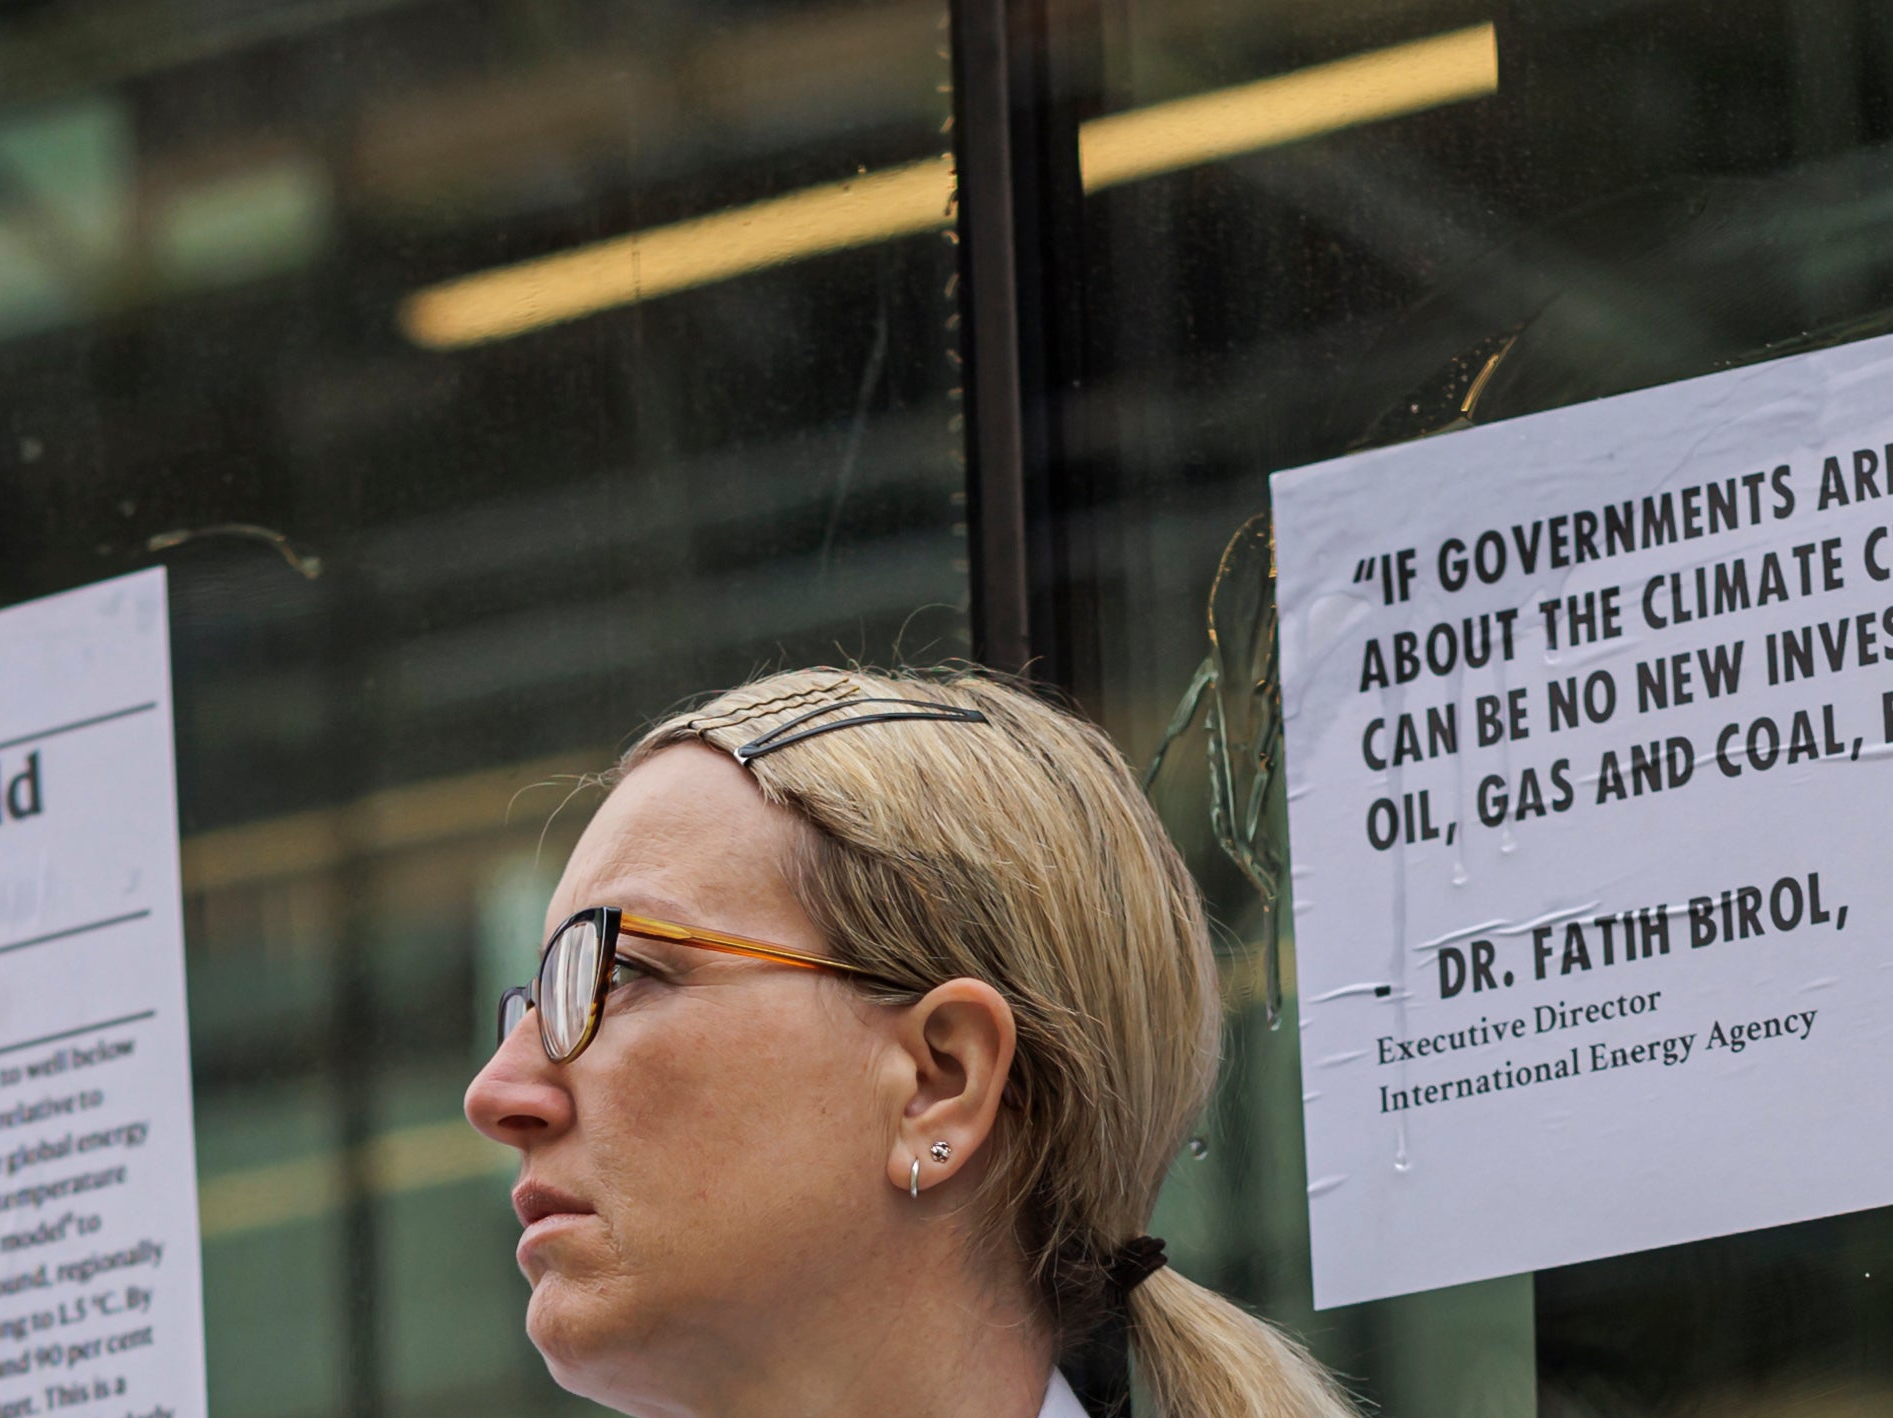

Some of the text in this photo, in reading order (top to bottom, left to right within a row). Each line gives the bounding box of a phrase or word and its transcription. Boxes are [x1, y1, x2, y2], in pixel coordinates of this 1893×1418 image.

[1438, 465, 1794, 592] GOVERNMENTS
[1360, 608, 1518, 692] ABOUT
[1539, 586, 1621, 650] THE
[1642, 538, 1843, 629] CLIMATE
[1363, 703, 1458, 771] CAN
[1476, 688, 1528, 747] BE
[1548, 670, 1616, 732] NO
[1637, 641, 1744, 713] NEW
[1367, 790, 1456, 850] OIL,
[1478, 759, 1573, 827] GAS
[1596, 737, 1694, 804] AND
[1716, 704, 1862, 777] COAL,
[1438, 940, 1513, 999] DR.
[1532, 904, 1669, 980] FATIH
[1688, 873, 1848, 948] BIROL,
[70, 1039, 135, 1069] below
[1378, 992, 1661, 1064] Executive Director
[1380, 1011, 1817, 1112] International Energy Agency
[75, 1121, 148, 1153] energy
[55, 1239, 163, 1284] regionally
[65, 1338, 102, 1368] per
[104, 1325, 153, 1354] cent
[44, 1384, 90, 1410] This
